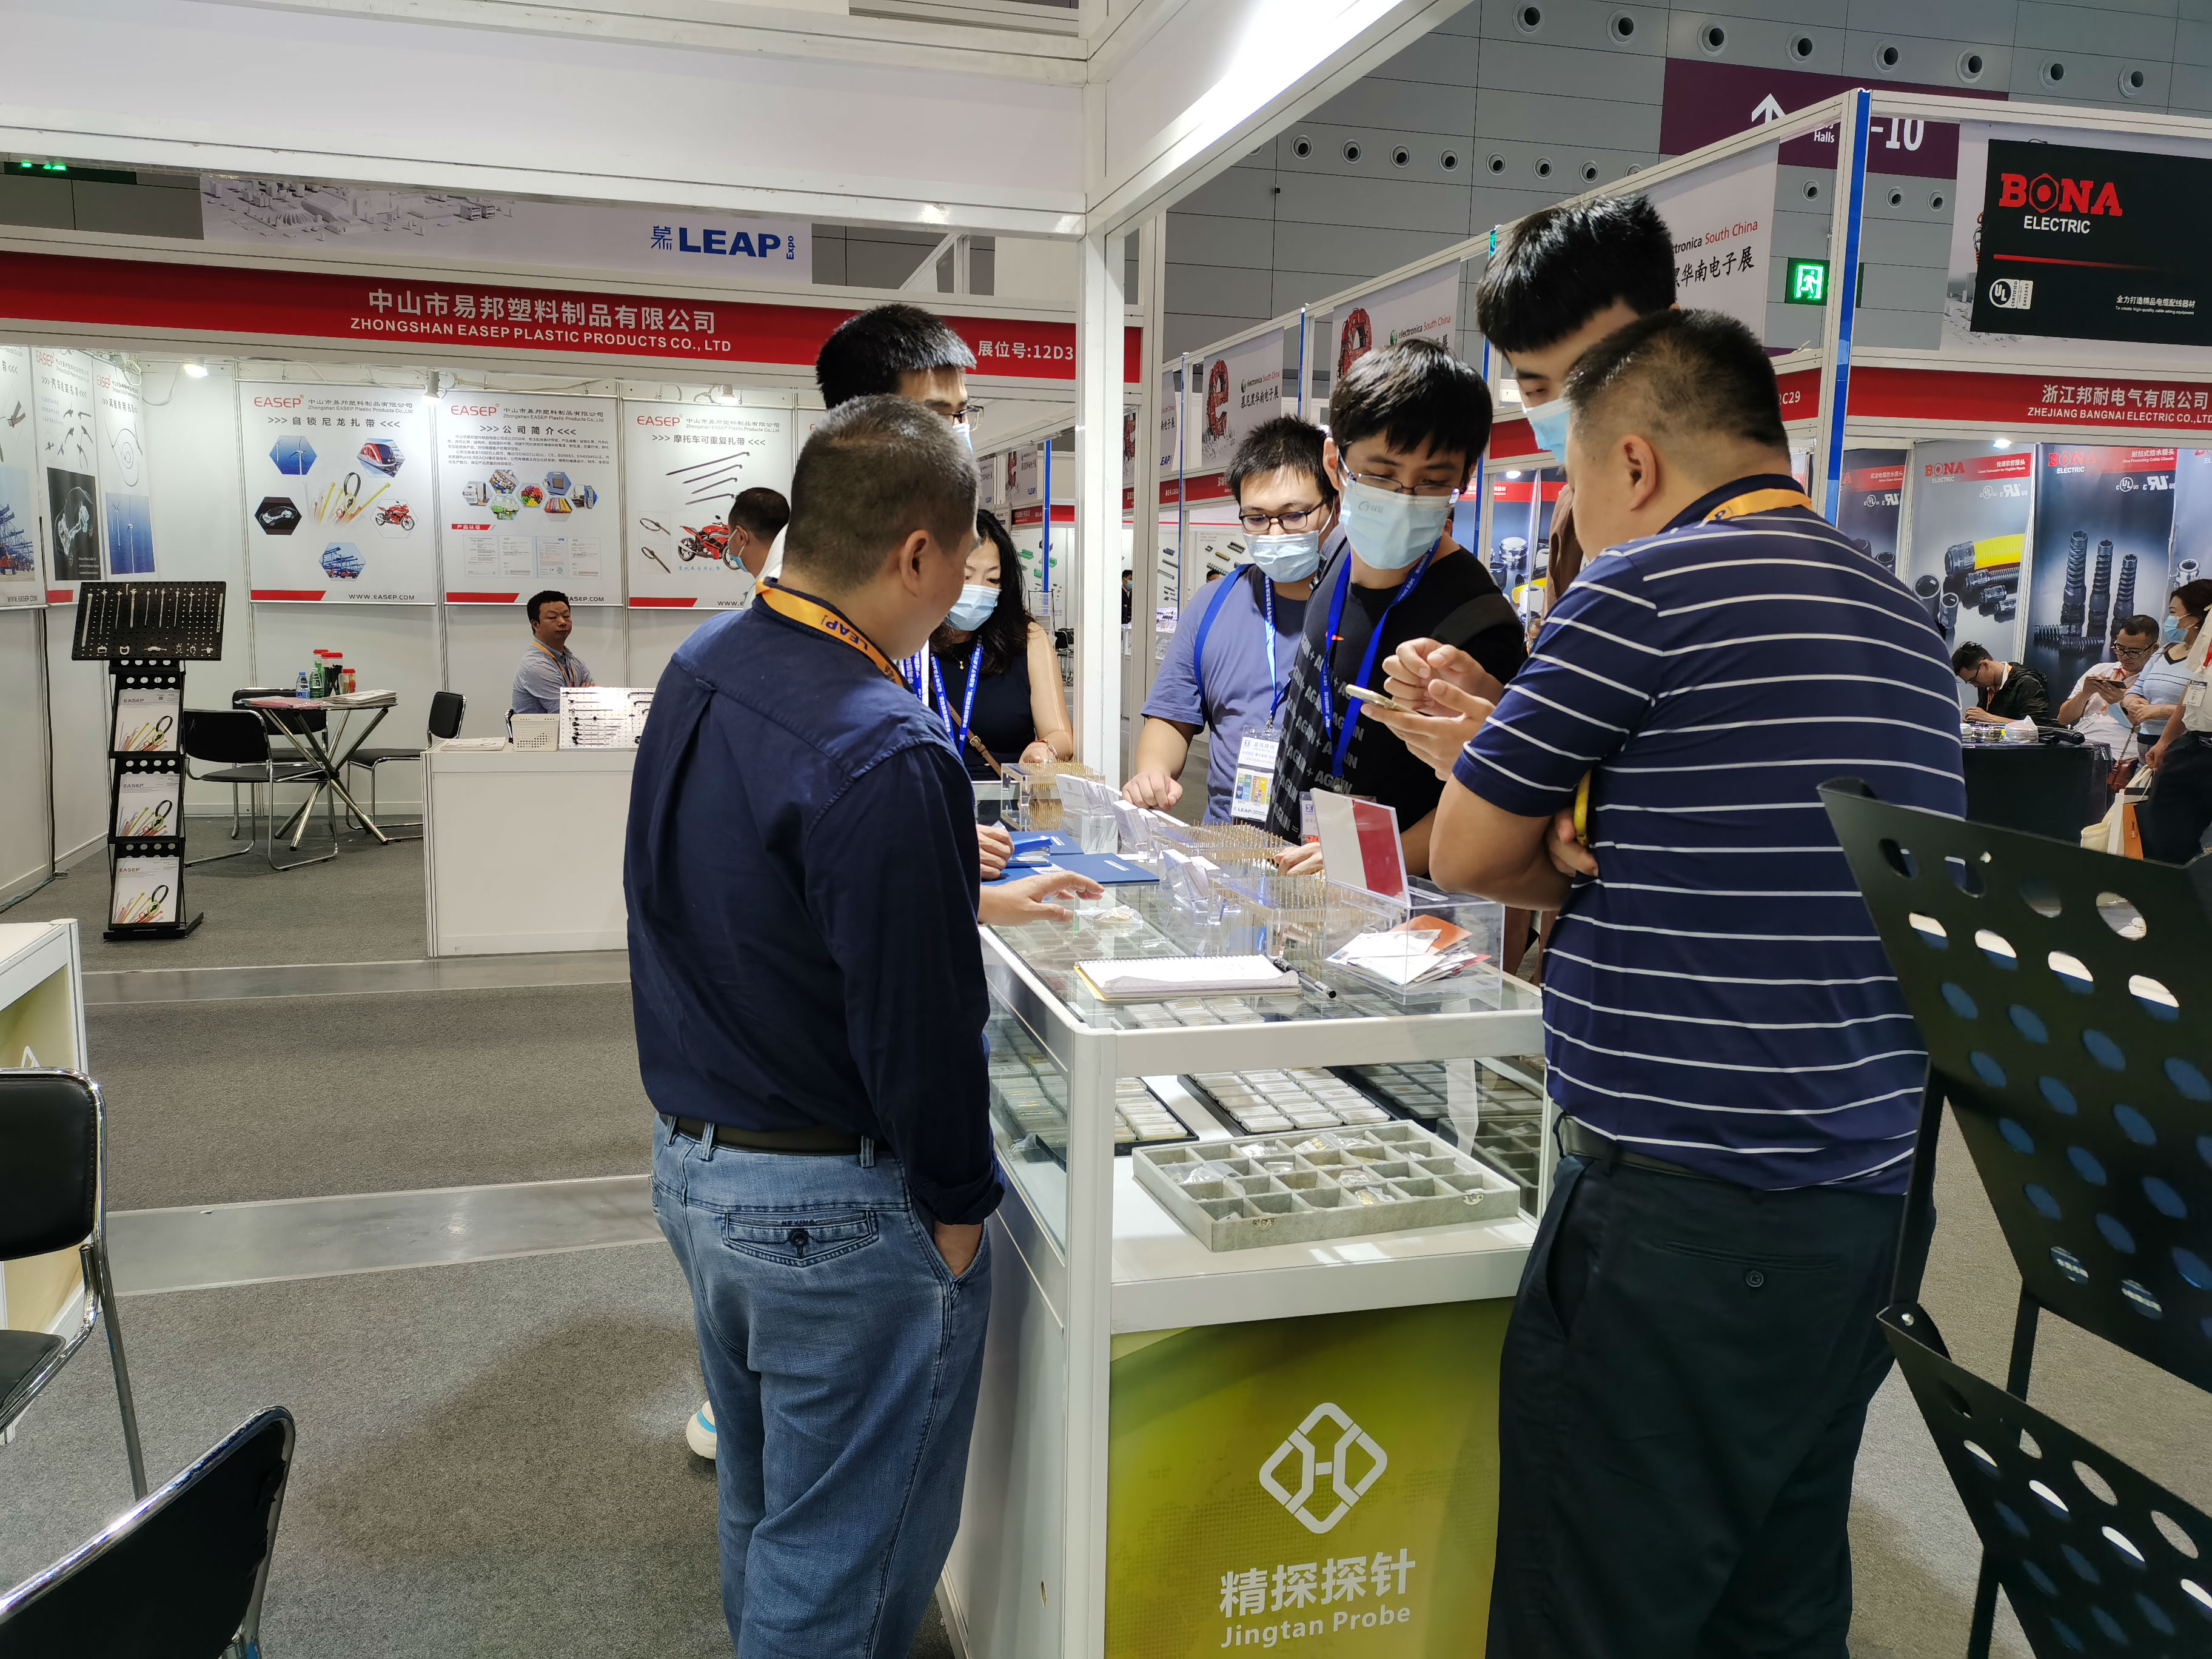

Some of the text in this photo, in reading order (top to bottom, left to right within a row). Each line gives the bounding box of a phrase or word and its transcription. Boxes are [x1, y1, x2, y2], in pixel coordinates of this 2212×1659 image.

[1814, 130, 1835, 144] Halls
[1999, 173, 2123, 216] BONA
[2023, 215, 2091, 234] ELECTRIC
[679, 227, 781, 258] LEAP
[786, 235, 796, 260] Expo
[1672, 221, 1758, 254] tronica South China
[369, 288, 716, 334] 中山市易邦塑料制品有限公司
[2116, 295, 2196, 309] 全力打造精品电缆配线器材
[350, 318, 731, 352] ZHONGSHAN EASEP PLASTIC PRODUCTS CO., LTD
[1398, 325, 1423, 338] electronica
[1423, 319, 1437, 332] South
[978, 340, 1074, 361] 展位号:12D3
[254, 397, 301, 409] EASEP
[2042, 384, 2209, 411] 浙江邦耐电气有限公司
[451, 405, 497, 417] EASEP
[637, 416, 680, 426] EASEP
[2027, 407, 2077, 418] ZHEJIANG
[2079, 409, 2125, 420] BANGNAI
[2127, 411, 2174, 422] ELECTRIC
[503, 425, 554, 435] 公司简介
[674, 434, 745, 446] 摩托车可重复扎带
[1925, 461, 1965, 477] BONA
[826, 620, 868, 651] LEAP
[1219, 1548, 1416, 1618] 精探探针
[1221, 1604, 1411, 1648] Jingtan Probe
